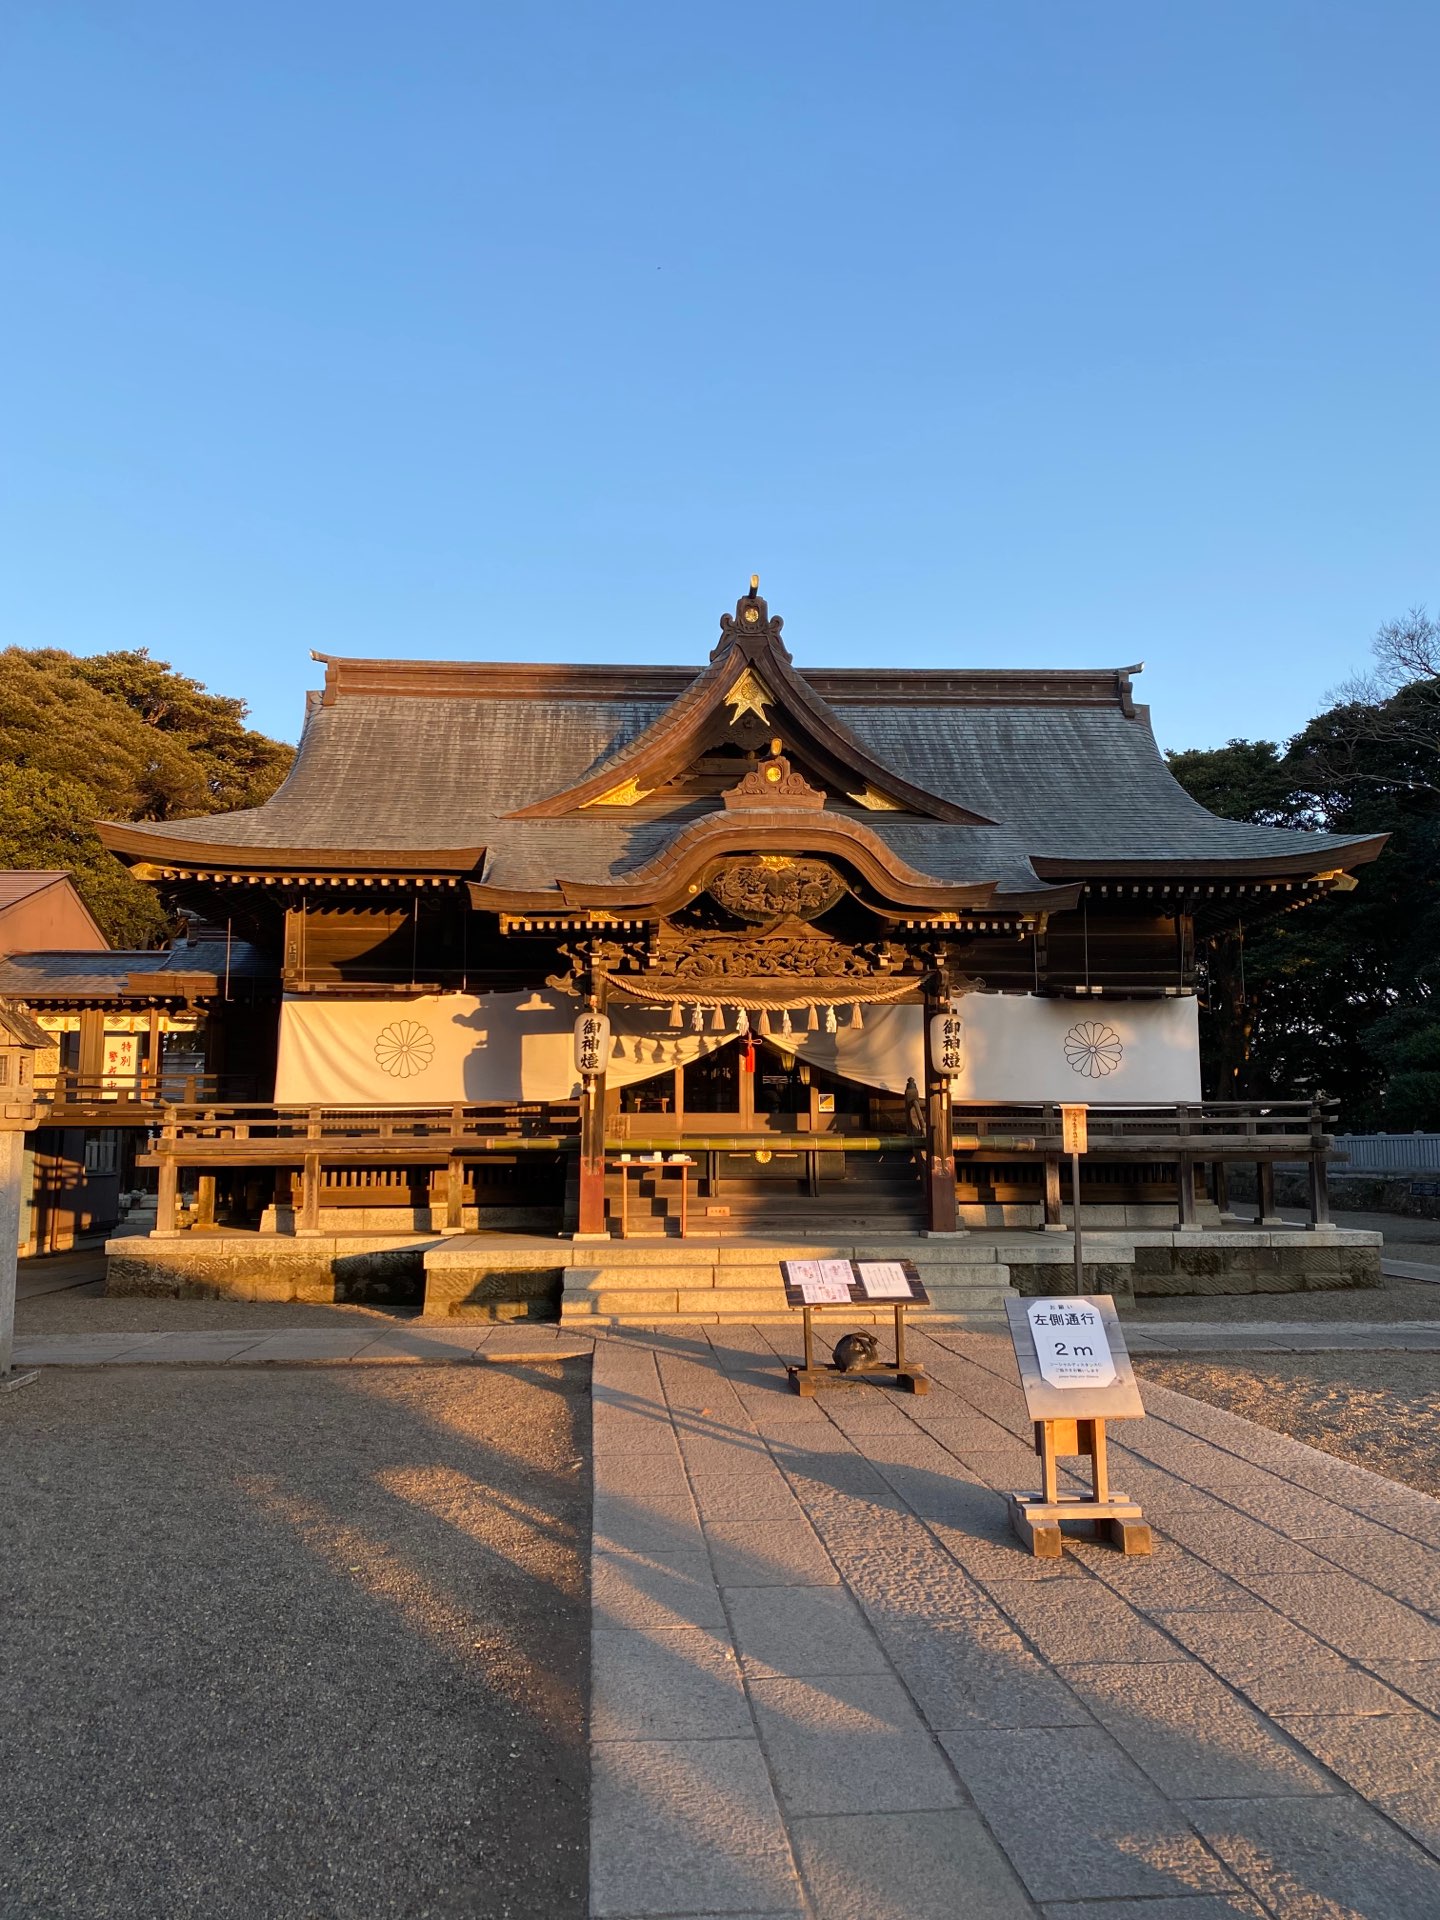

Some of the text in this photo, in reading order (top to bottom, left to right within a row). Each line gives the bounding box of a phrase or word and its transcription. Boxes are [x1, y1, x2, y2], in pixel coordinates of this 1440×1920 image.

[119, 1041, 132, 1067] 特別
[580, 1018, 602, 1069] 御神燈
[942, 1018, 961, 1069] 御神燈
[1033, 1312, 1095, 1326] 左側通行
